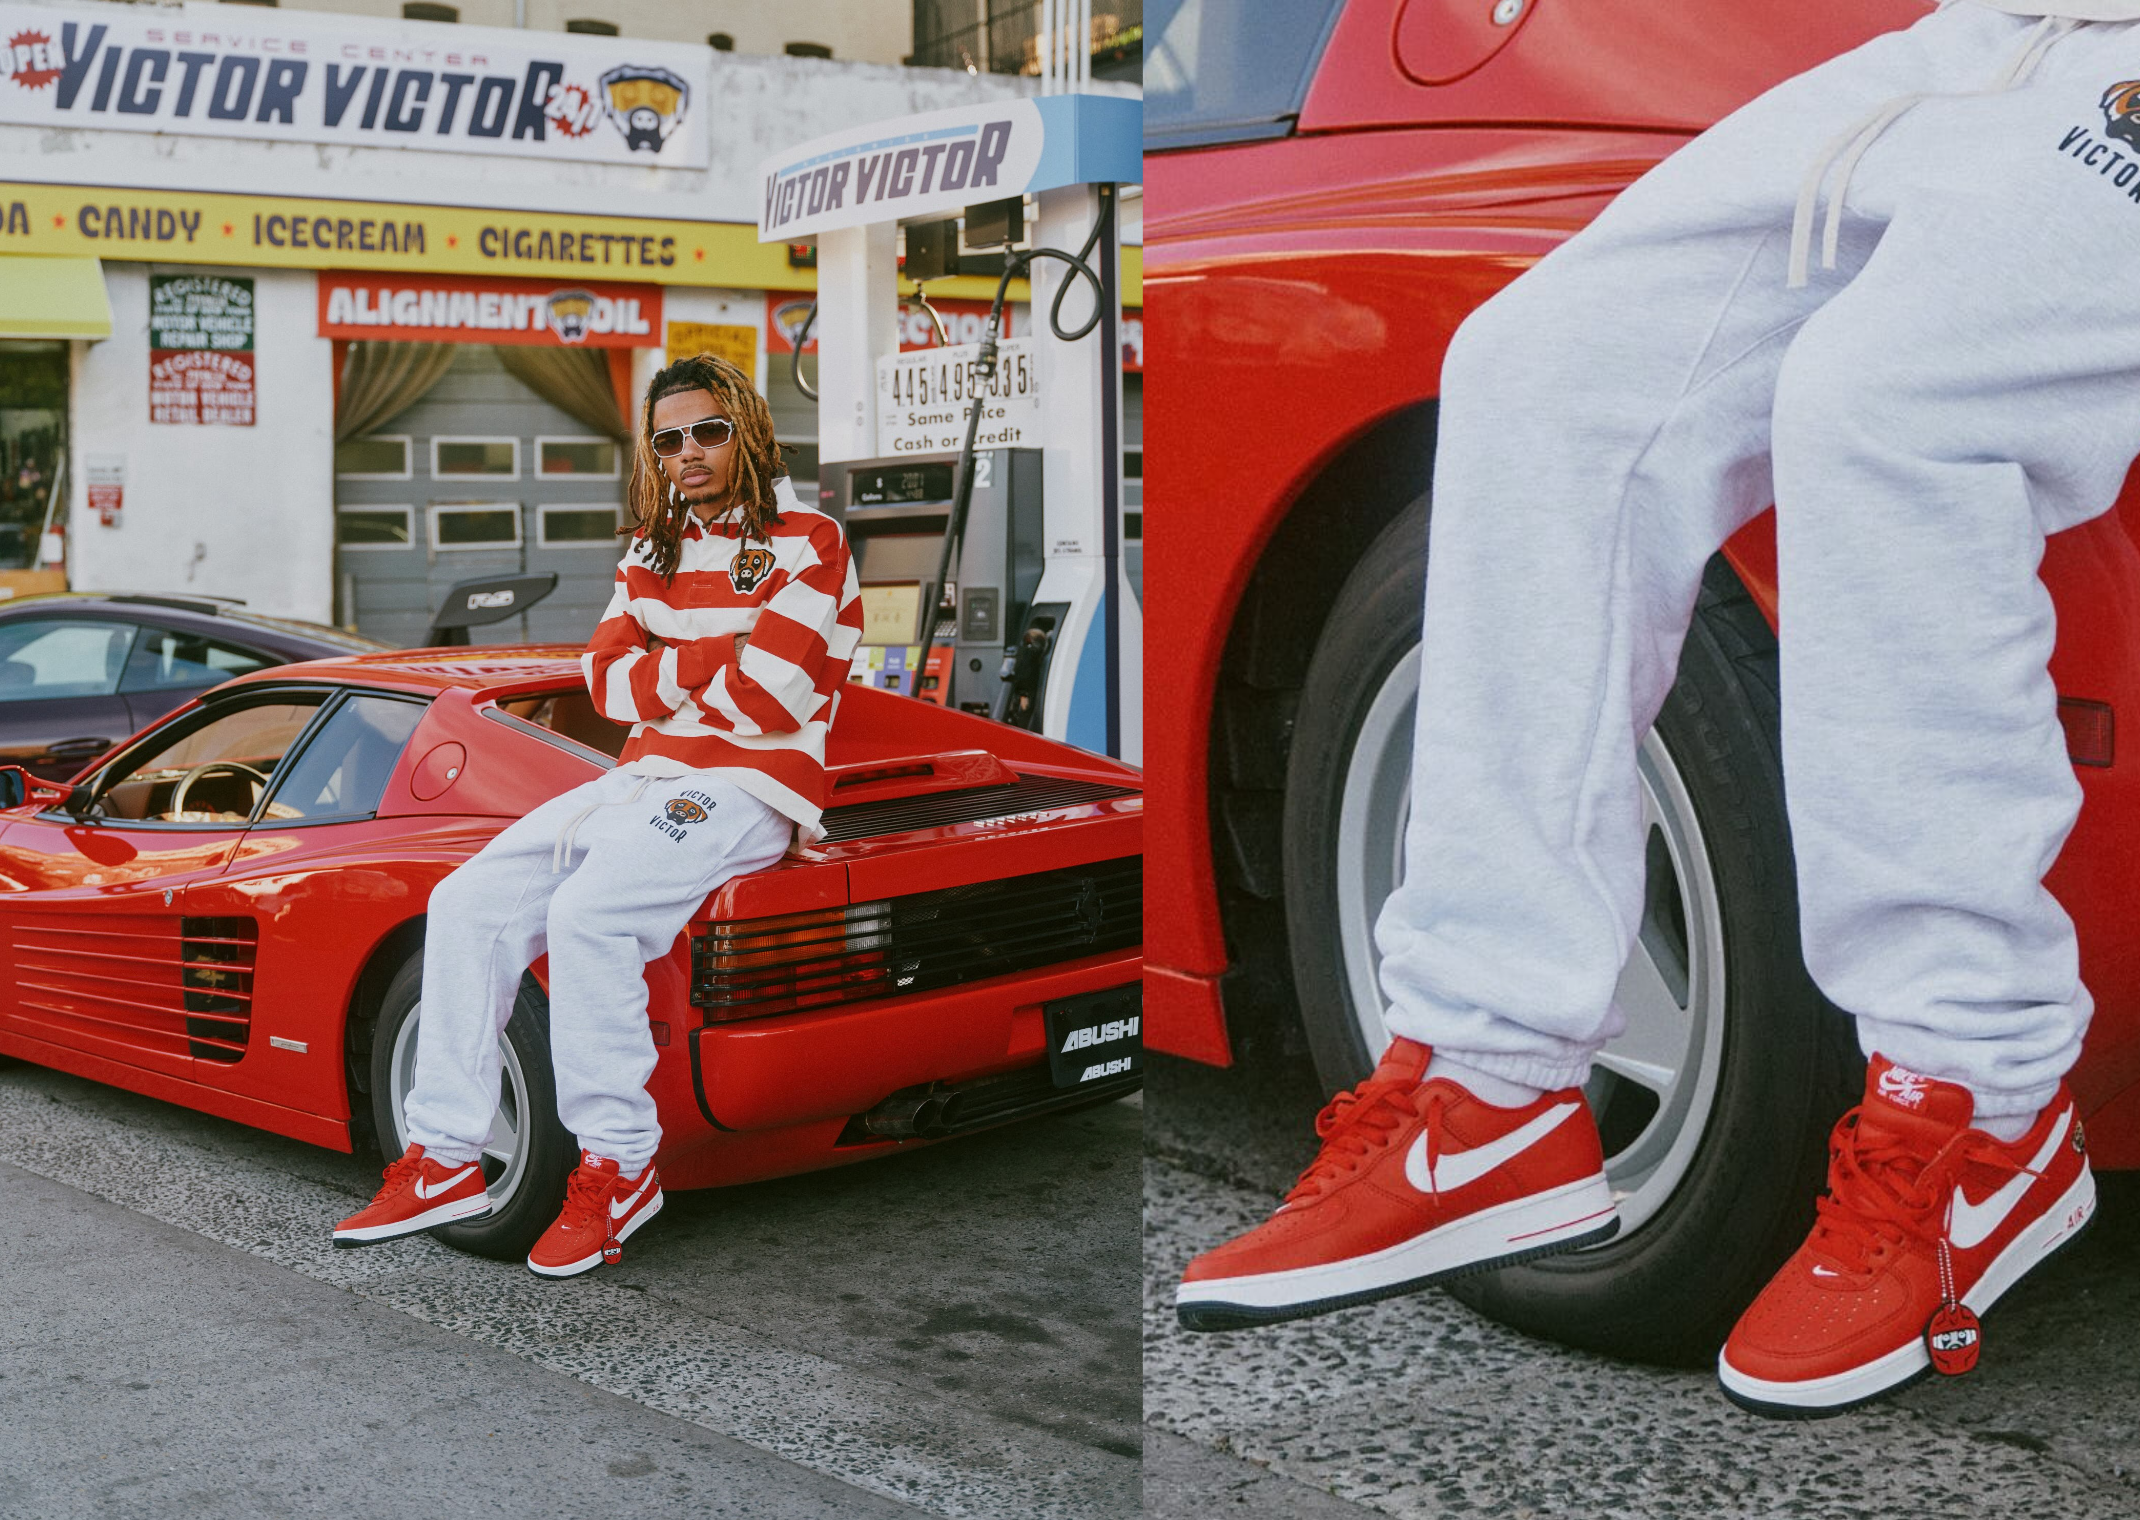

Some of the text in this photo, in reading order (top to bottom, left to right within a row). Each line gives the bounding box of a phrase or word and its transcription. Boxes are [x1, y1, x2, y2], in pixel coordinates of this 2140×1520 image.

[147, 29, 489, 67] SERVICE CENTER
[56, 22, 563, 141] VICTOR VICTOR
[544, 83, 602, 133] 24/7
[765, 120, 1012, 233] VICTOR VICTOR
[79, 205, 201, 243] CANDY
[255, 214, 425, 254] ICECREAM
[479, 227, 676, 267] CIGARETTES
[327, 287, 650, 335] ALIGNMENT OIL
[908, 411, 954, 427] Same
[963, 405, 1006, 421] Pice
[894, 427, 1021, 451] Cash or redit
[974, 458, 991, 488] 2
[680, 789, 717, 812] VICTOR
[649, 815, 688, 844] VICTOR
[1061, 1016, 1140, 1054] ABUSHI
[1079, 1057, 1132, 1082] ABUSHI
[2066, 1206, 2084, 1228] AIR
